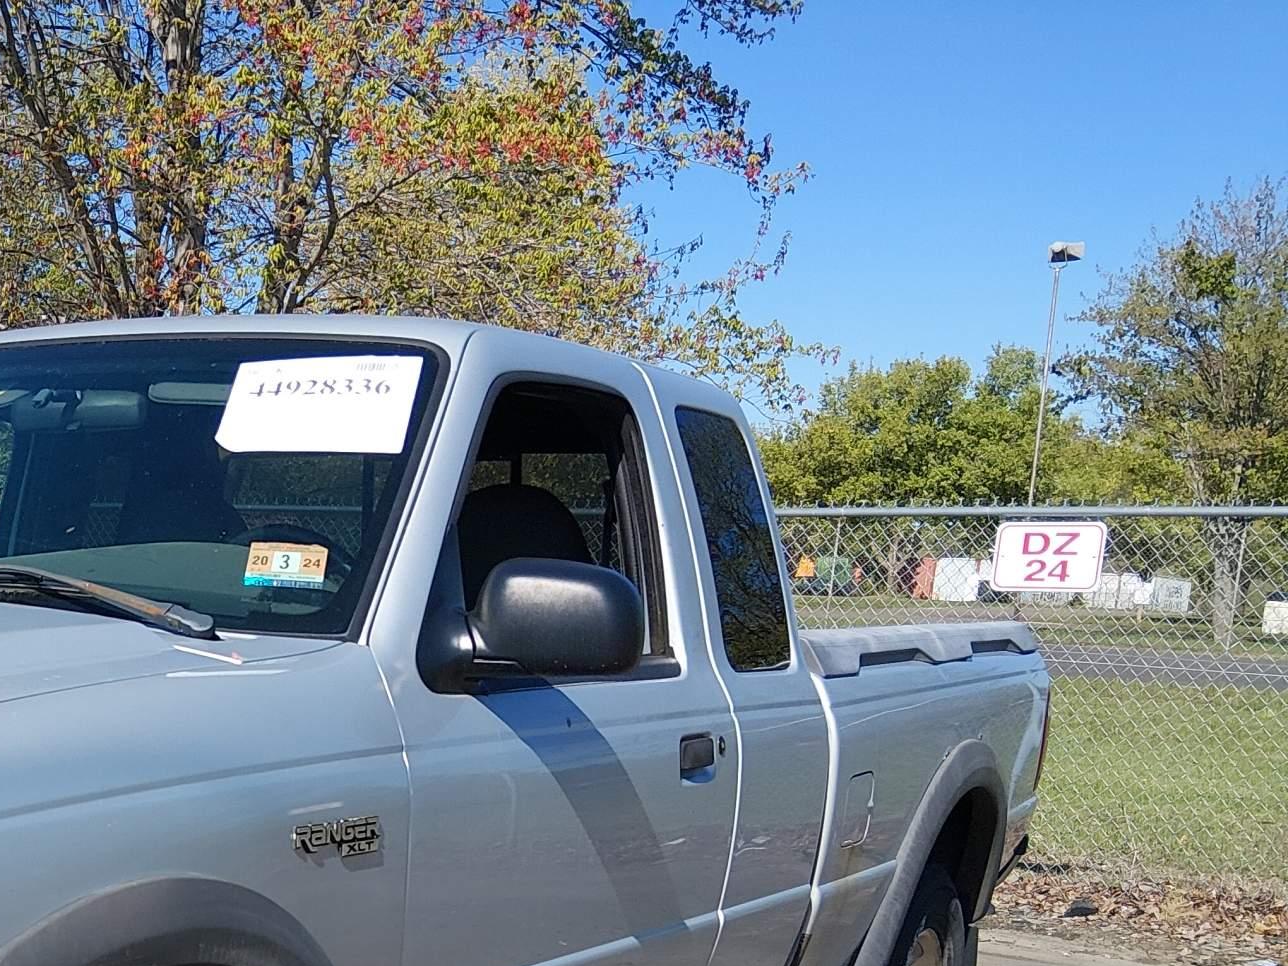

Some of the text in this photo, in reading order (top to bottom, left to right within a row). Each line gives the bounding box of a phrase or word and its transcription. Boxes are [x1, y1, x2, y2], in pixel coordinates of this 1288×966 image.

[249, 378, 391, 397] 44928336
[1021, 532, 1081, 556] DZ
[252, 554, 321, 570] 20 3 24
[1023, 559, 1070, 582] 24
[347, 841, 374, 854] XLT
